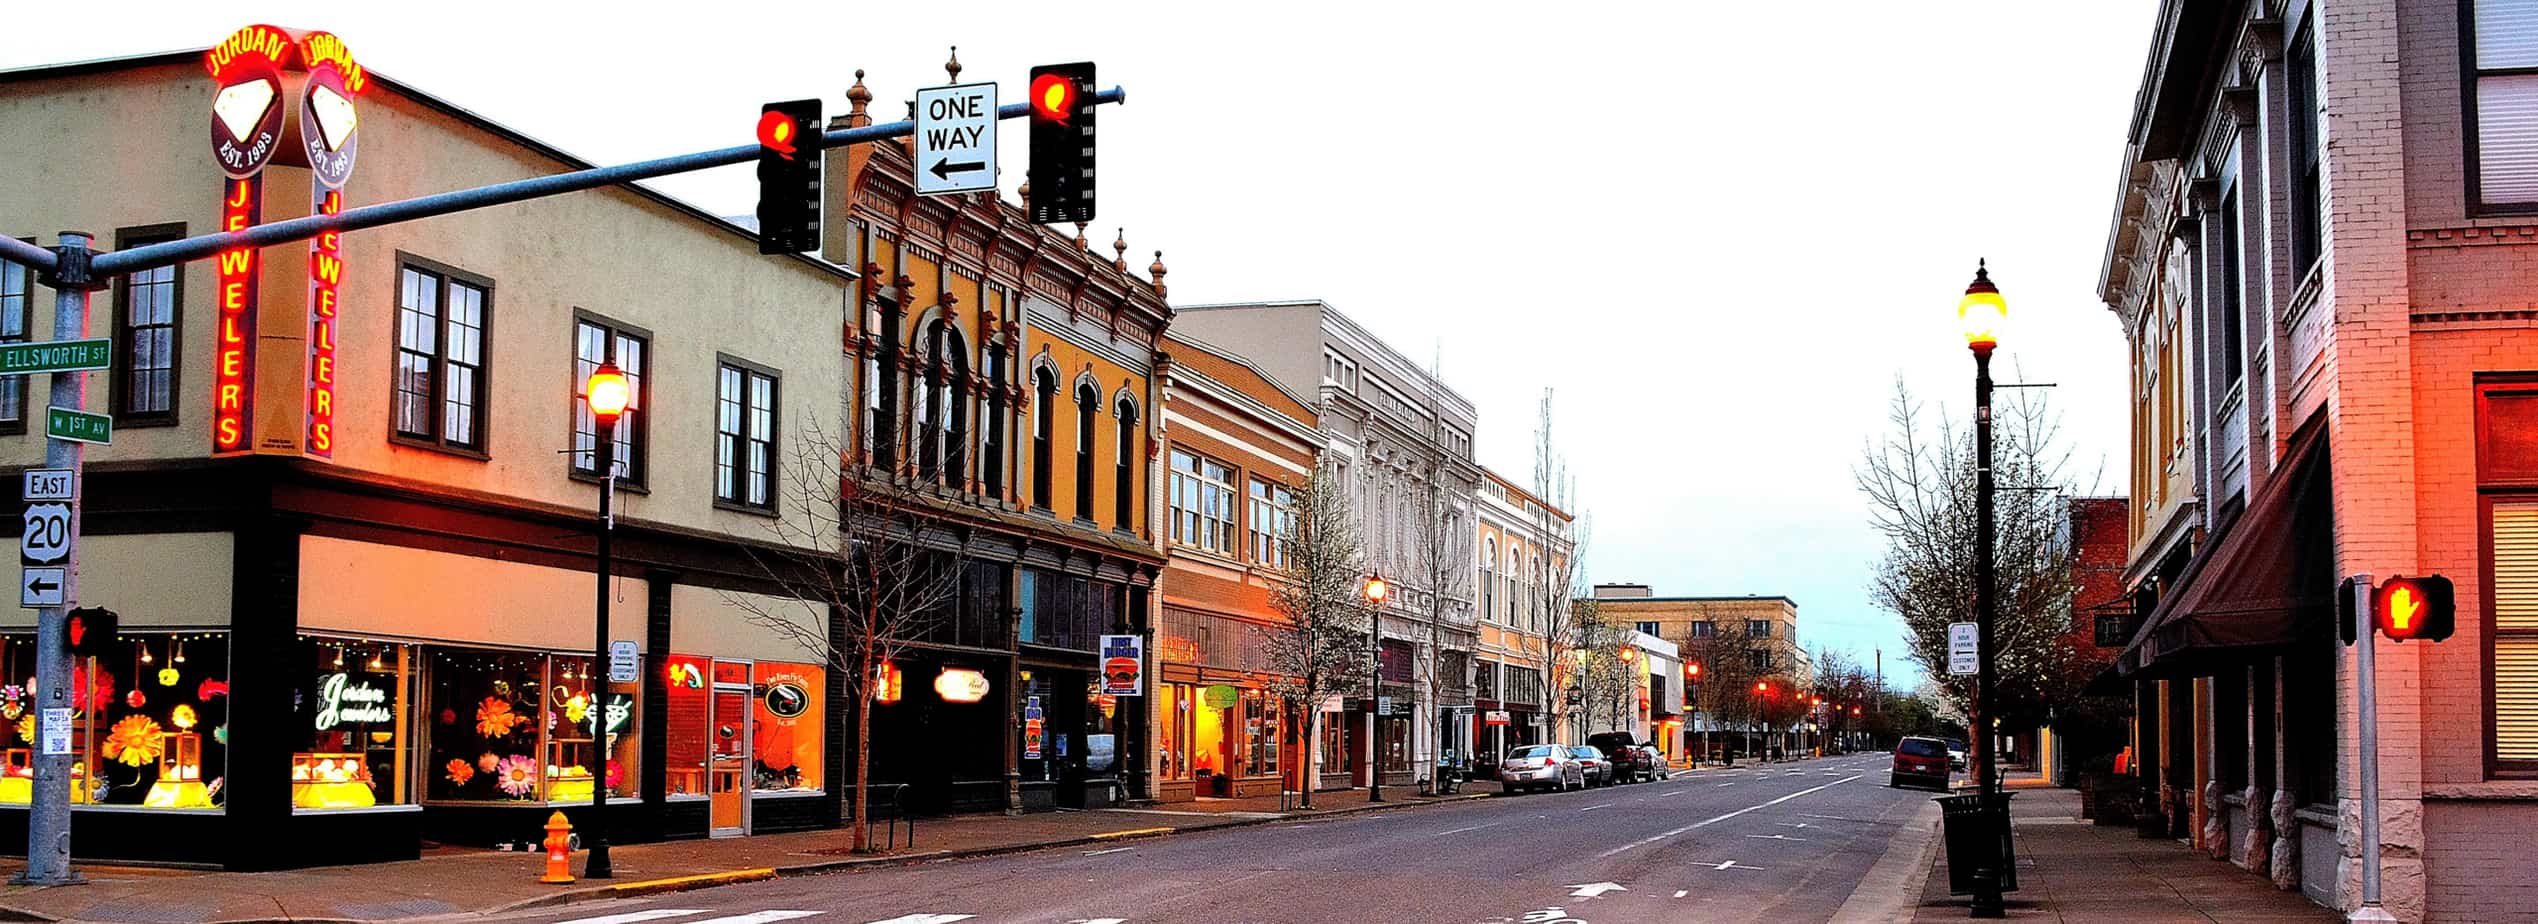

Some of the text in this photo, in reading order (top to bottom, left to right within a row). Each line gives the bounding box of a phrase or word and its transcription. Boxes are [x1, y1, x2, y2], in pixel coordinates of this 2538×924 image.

[209, 26, 287, 77] JORDAN
[305, 33, 365, 92] JORDAN
[930, 95, 984, 121] ONE
[219, 131, 273, 168] EST. 1993
[927, 125, 985, 151] WAY
[310, 138, 329, 175] EST.
[218, 180, 250, 445] JEWELERS
[316, 192, 341, 450] JEWELERS
[6, 346, 106, 368] ELLSWORTH ST
[54, 416, 105, 435] W 1ST AV
[31, 475, 67, 495] EAST
[27, 515, 65, 549] 20
